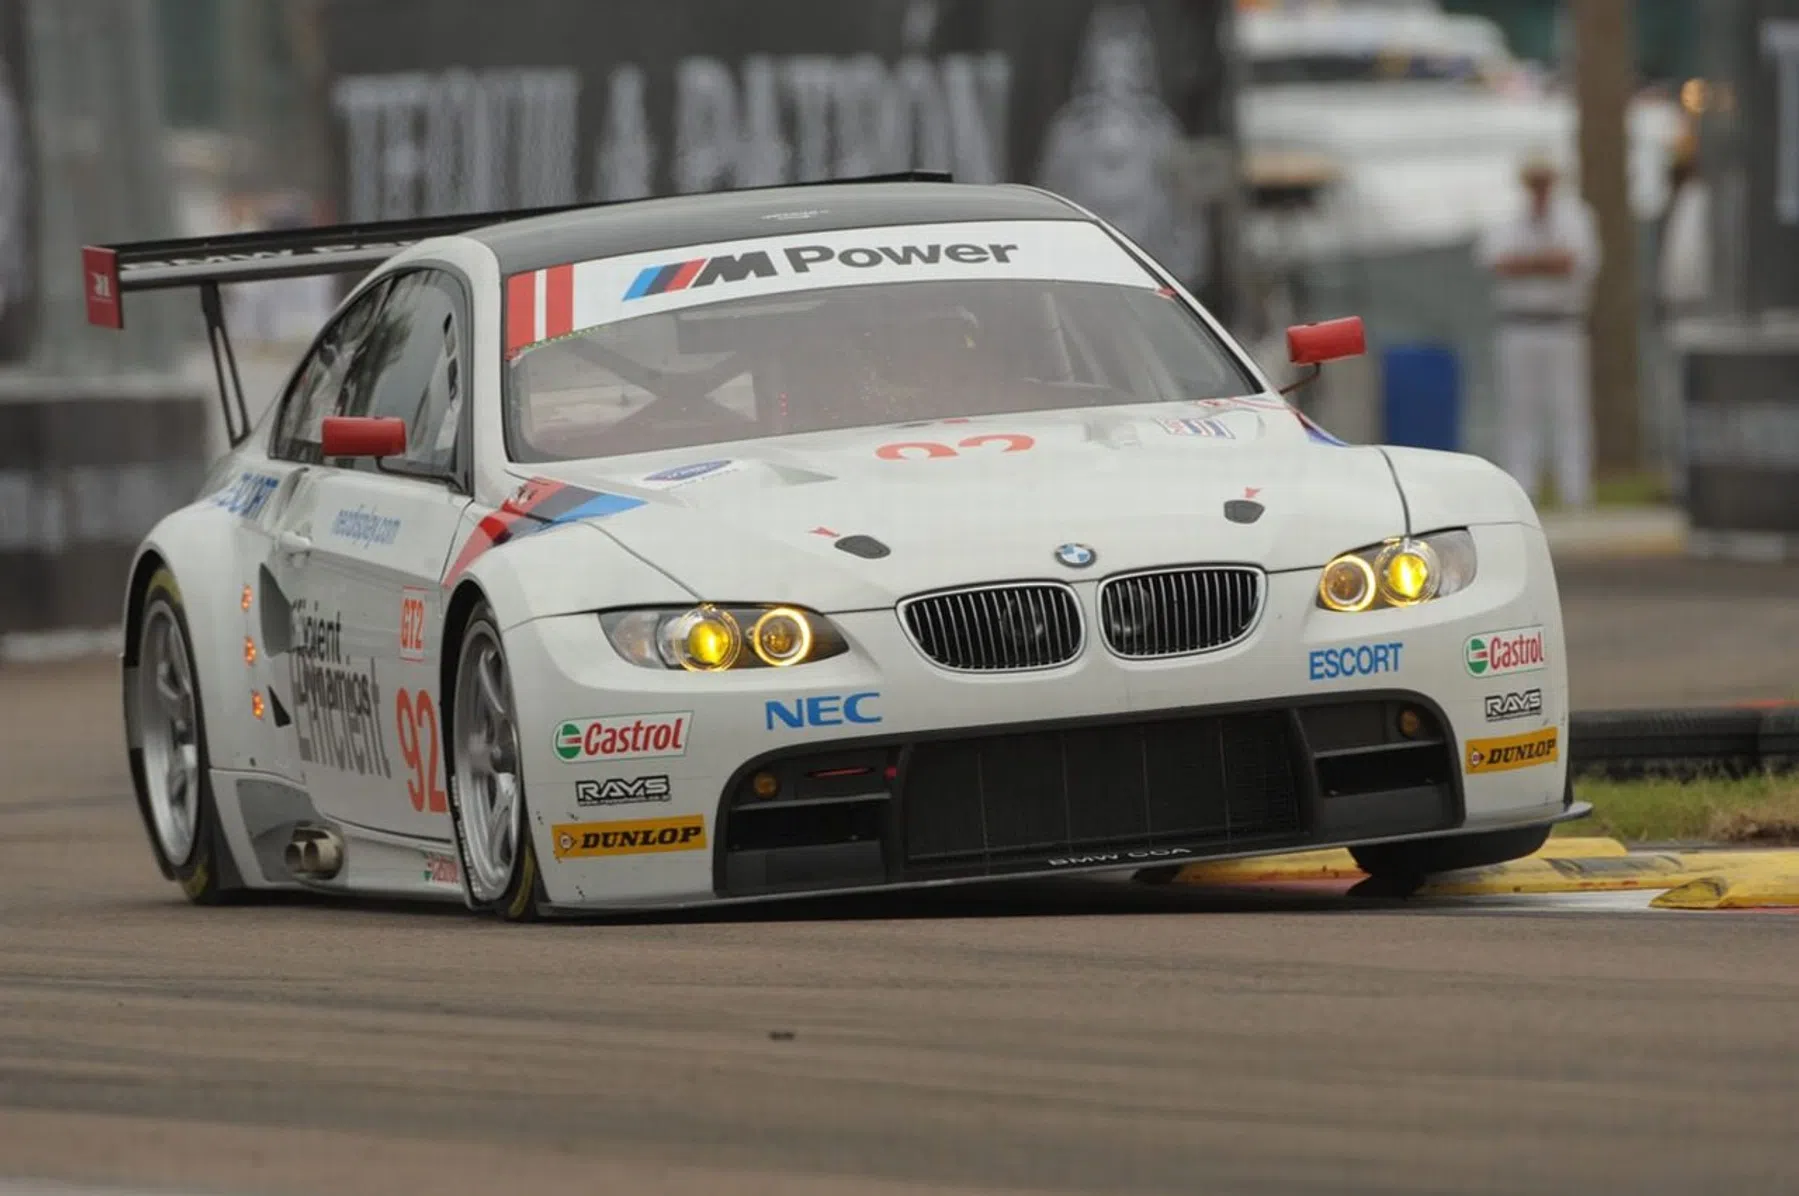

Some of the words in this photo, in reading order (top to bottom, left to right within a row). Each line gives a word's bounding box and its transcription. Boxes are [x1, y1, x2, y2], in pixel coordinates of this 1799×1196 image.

[783, 243, 1019, 274] Power
[401, 597, 425, 651] GT2
[1308, 643, 1403, 681] ESCORT
[1489, 631, 1544, 670] Castrol
[765, 692, 883, 731] NEC
[1485, 688, 1542, 718] RAYS
[396, 687, 448, 813] 92
[584, 718, 683, 756] Castrol
[1486, 738, 1557, 765] DUNLOP
[576, 775, 670, 801] RAYS
[581, 826, 703, 849] DUNLOP
